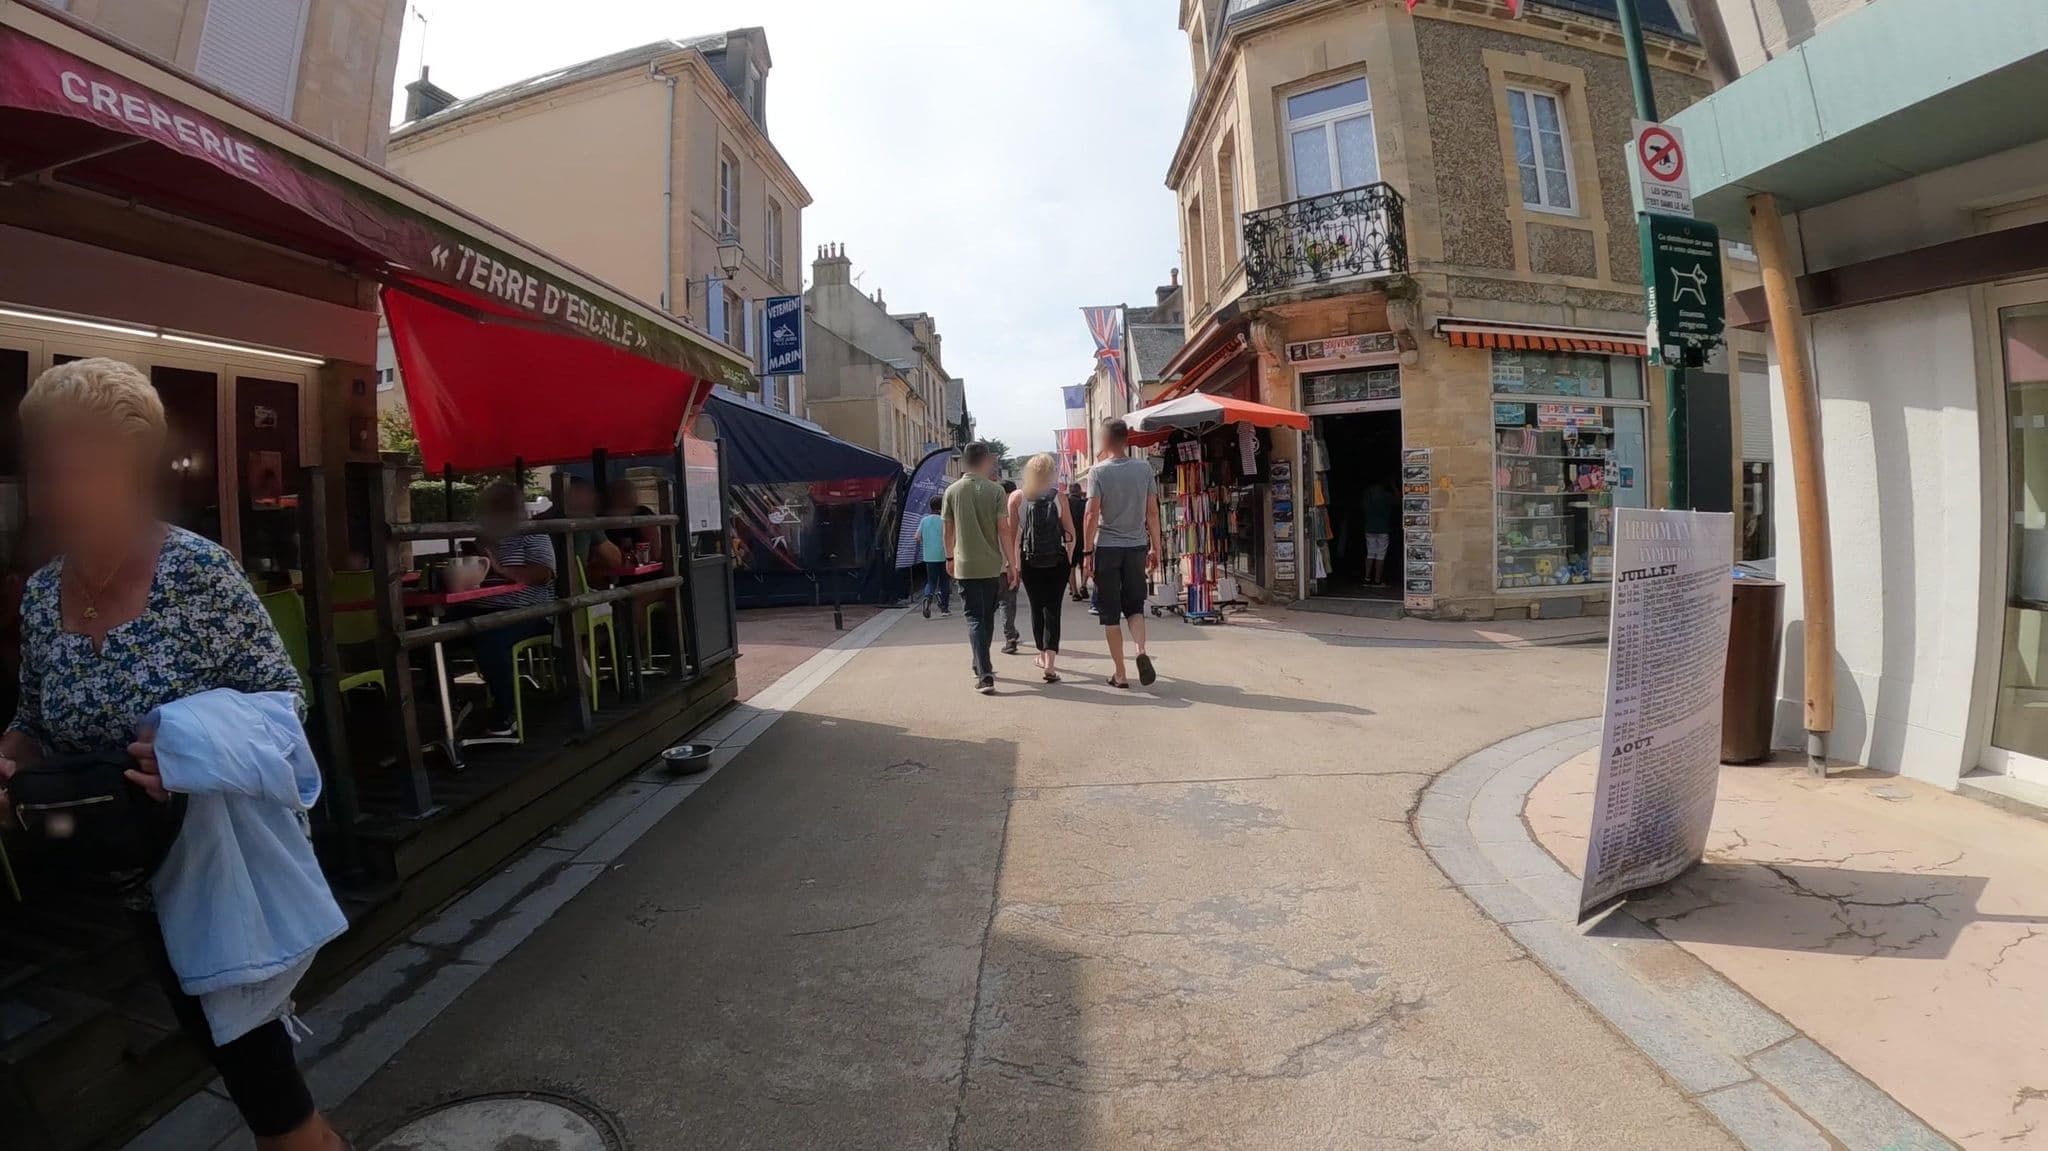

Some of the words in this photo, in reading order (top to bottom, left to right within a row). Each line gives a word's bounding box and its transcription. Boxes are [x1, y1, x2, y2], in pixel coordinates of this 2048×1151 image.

[60, 71, 260, 174] CREPERIE
[455, 243, 538, 310] TERRE
[769, 349, 802, 369] MARIN
[1618, 564, 1677, 583] JUILLET
